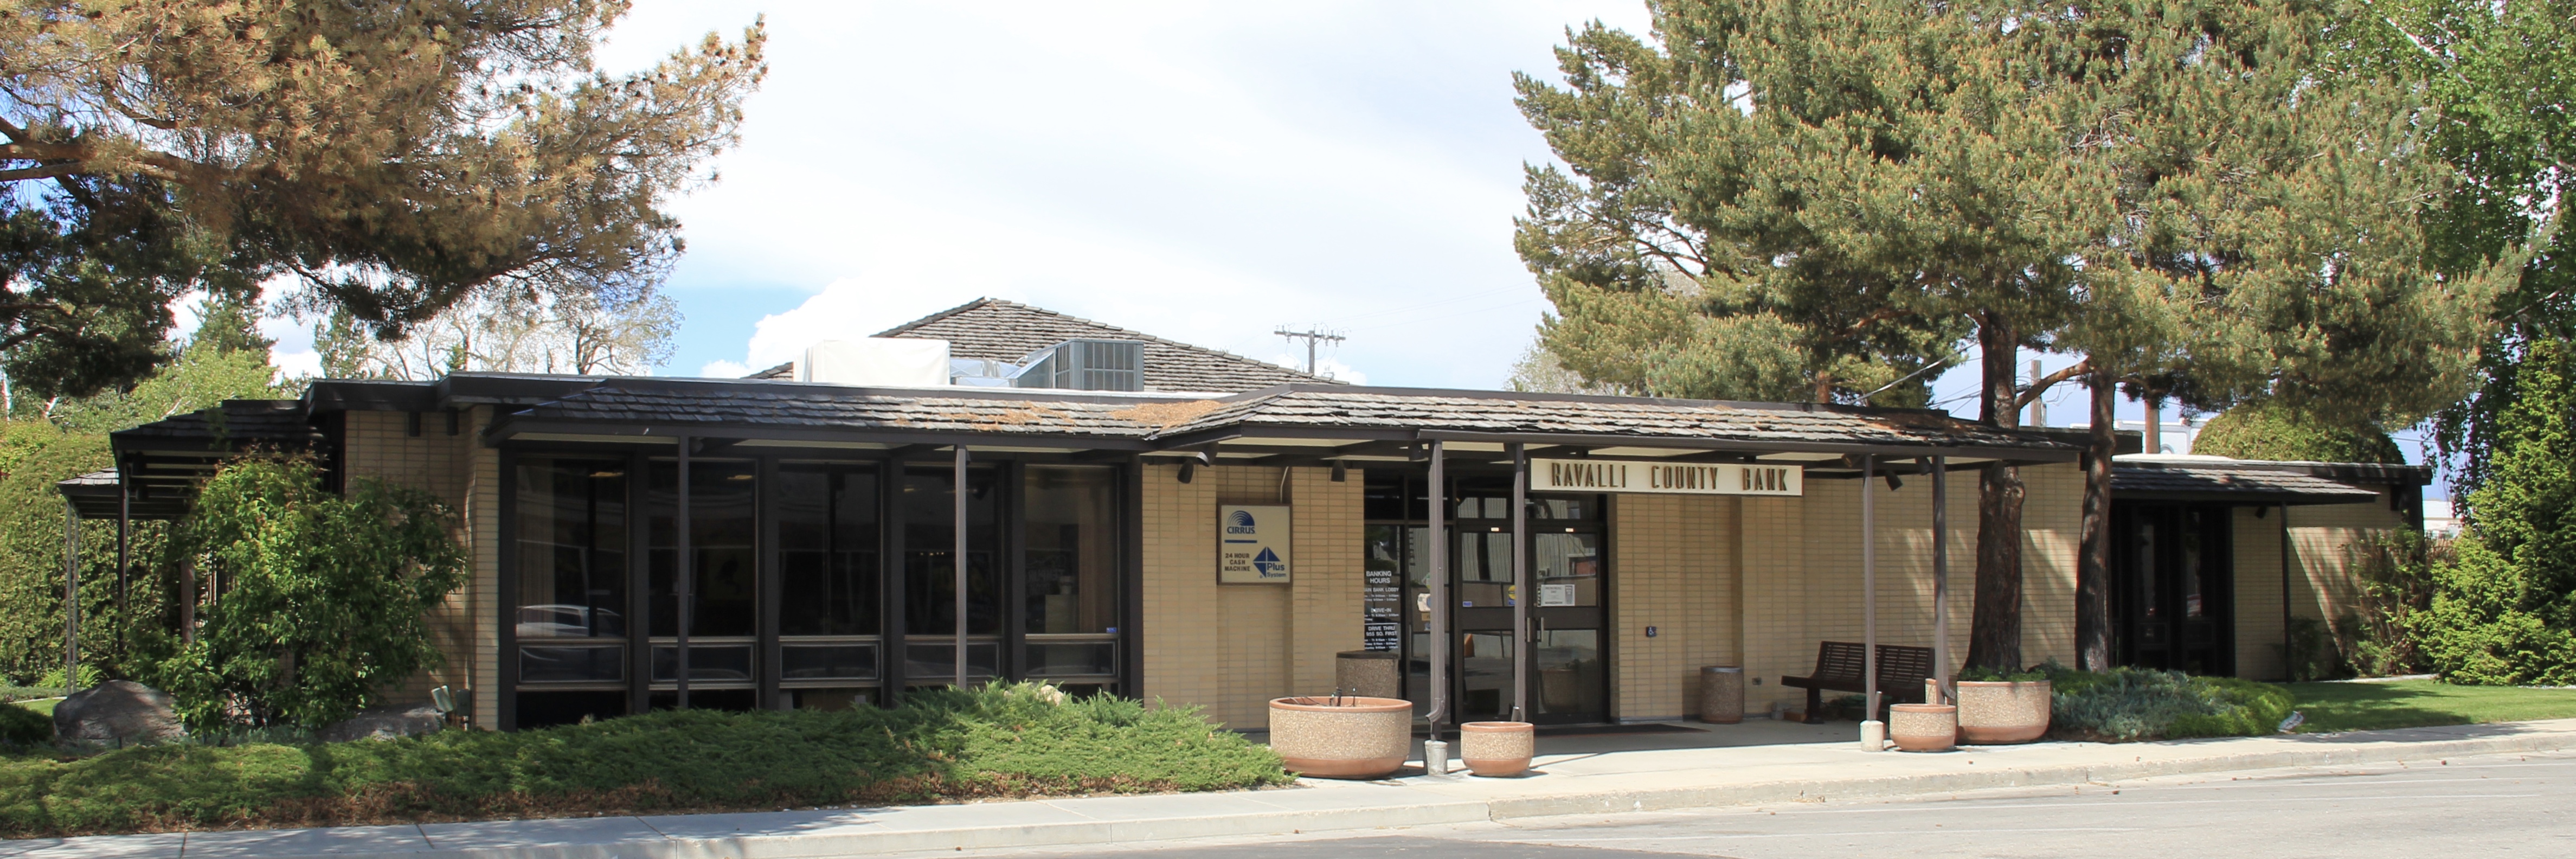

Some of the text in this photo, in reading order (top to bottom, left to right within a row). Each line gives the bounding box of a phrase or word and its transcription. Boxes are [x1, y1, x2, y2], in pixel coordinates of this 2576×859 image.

[1551, 462, 1788, 491] RAVALLI COUNTY BANK
[1227, 526, 1255, 534] CIRRUS
[1267, 562, 1285, 571] Plus
